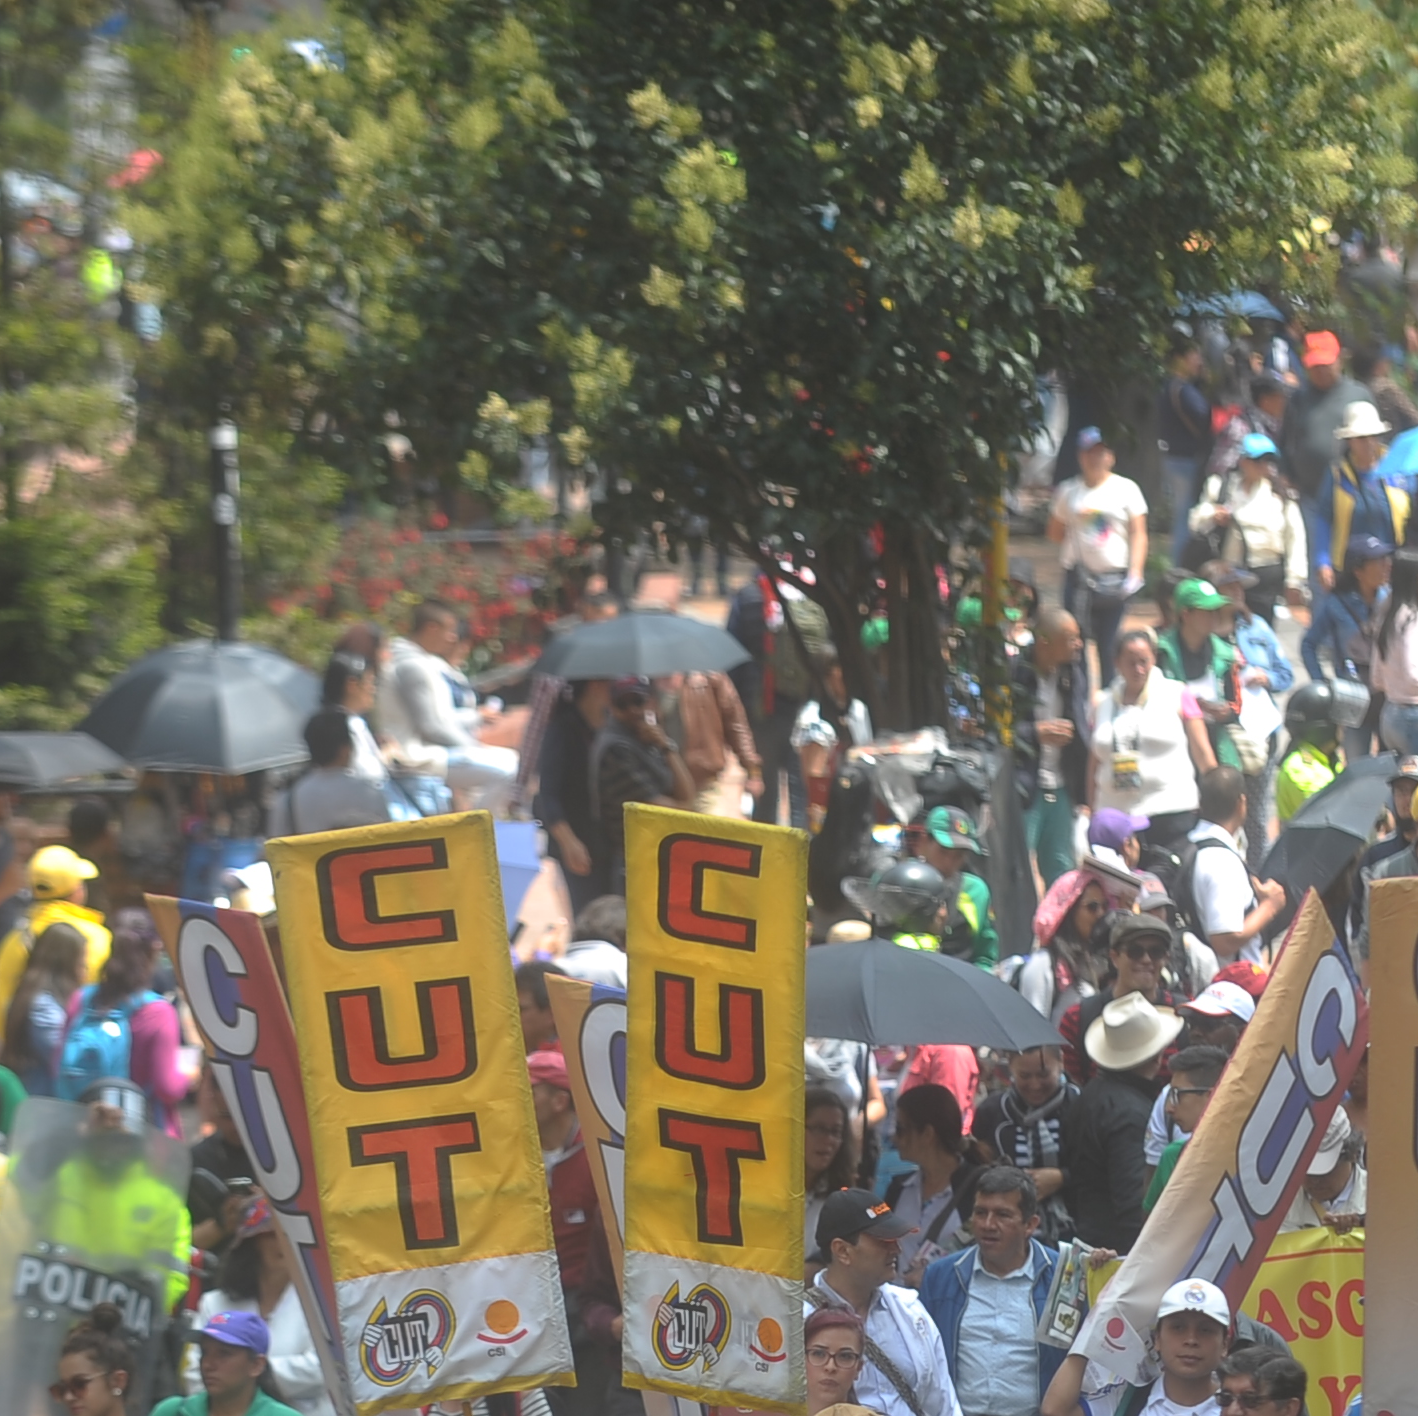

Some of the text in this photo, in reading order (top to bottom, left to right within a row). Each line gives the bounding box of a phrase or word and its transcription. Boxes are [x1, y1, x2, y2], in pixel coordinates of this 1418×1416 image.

[316, 837, 480, 1249] CUT
[655, 833, 765, 1246] CUT
[1189, 949, 1358, 1285] CUT
[487, 1347, 507, 1358] CSI
